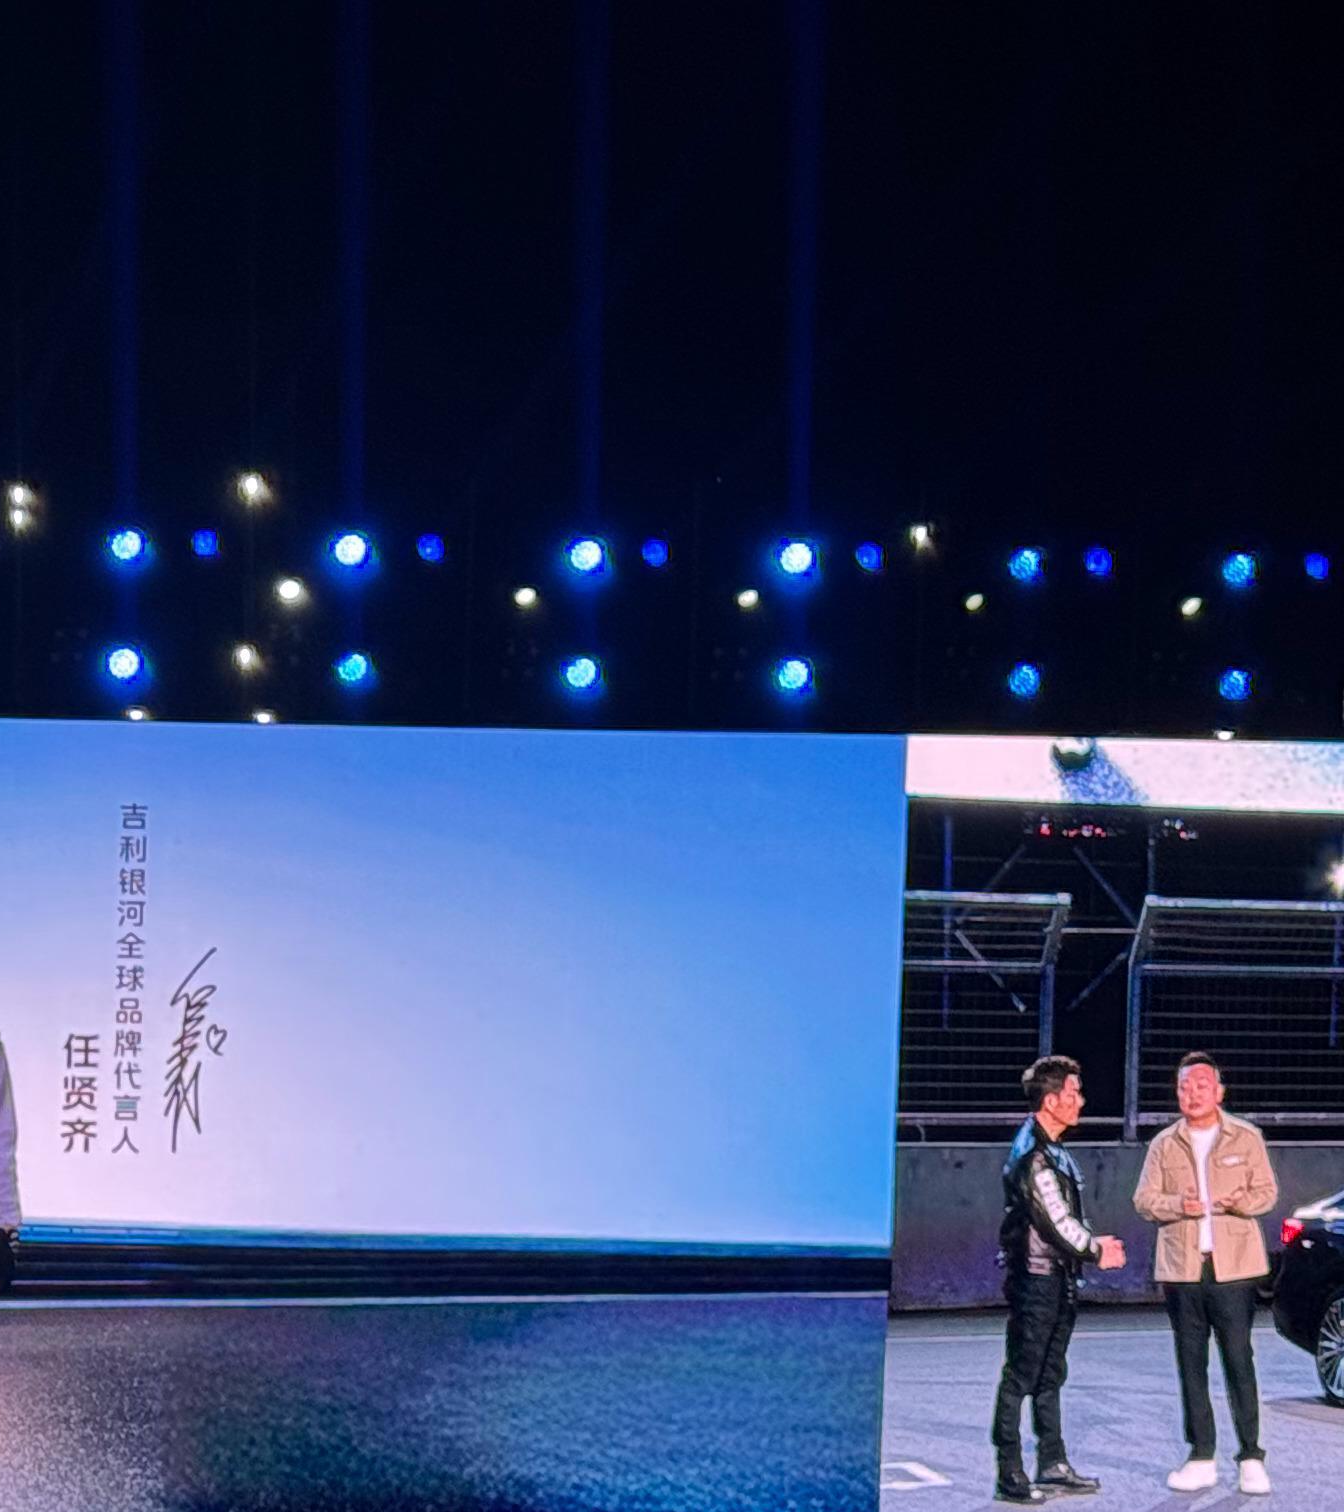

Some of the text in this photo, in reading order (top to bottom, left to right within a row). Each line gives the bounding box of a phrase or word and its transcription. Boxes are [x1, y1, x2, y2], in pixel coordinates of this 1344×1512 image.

[60, 1032, 101, 1154] 任贤齐
[111, 803, 149, 1154] 吉利银河全球品牌代言人
